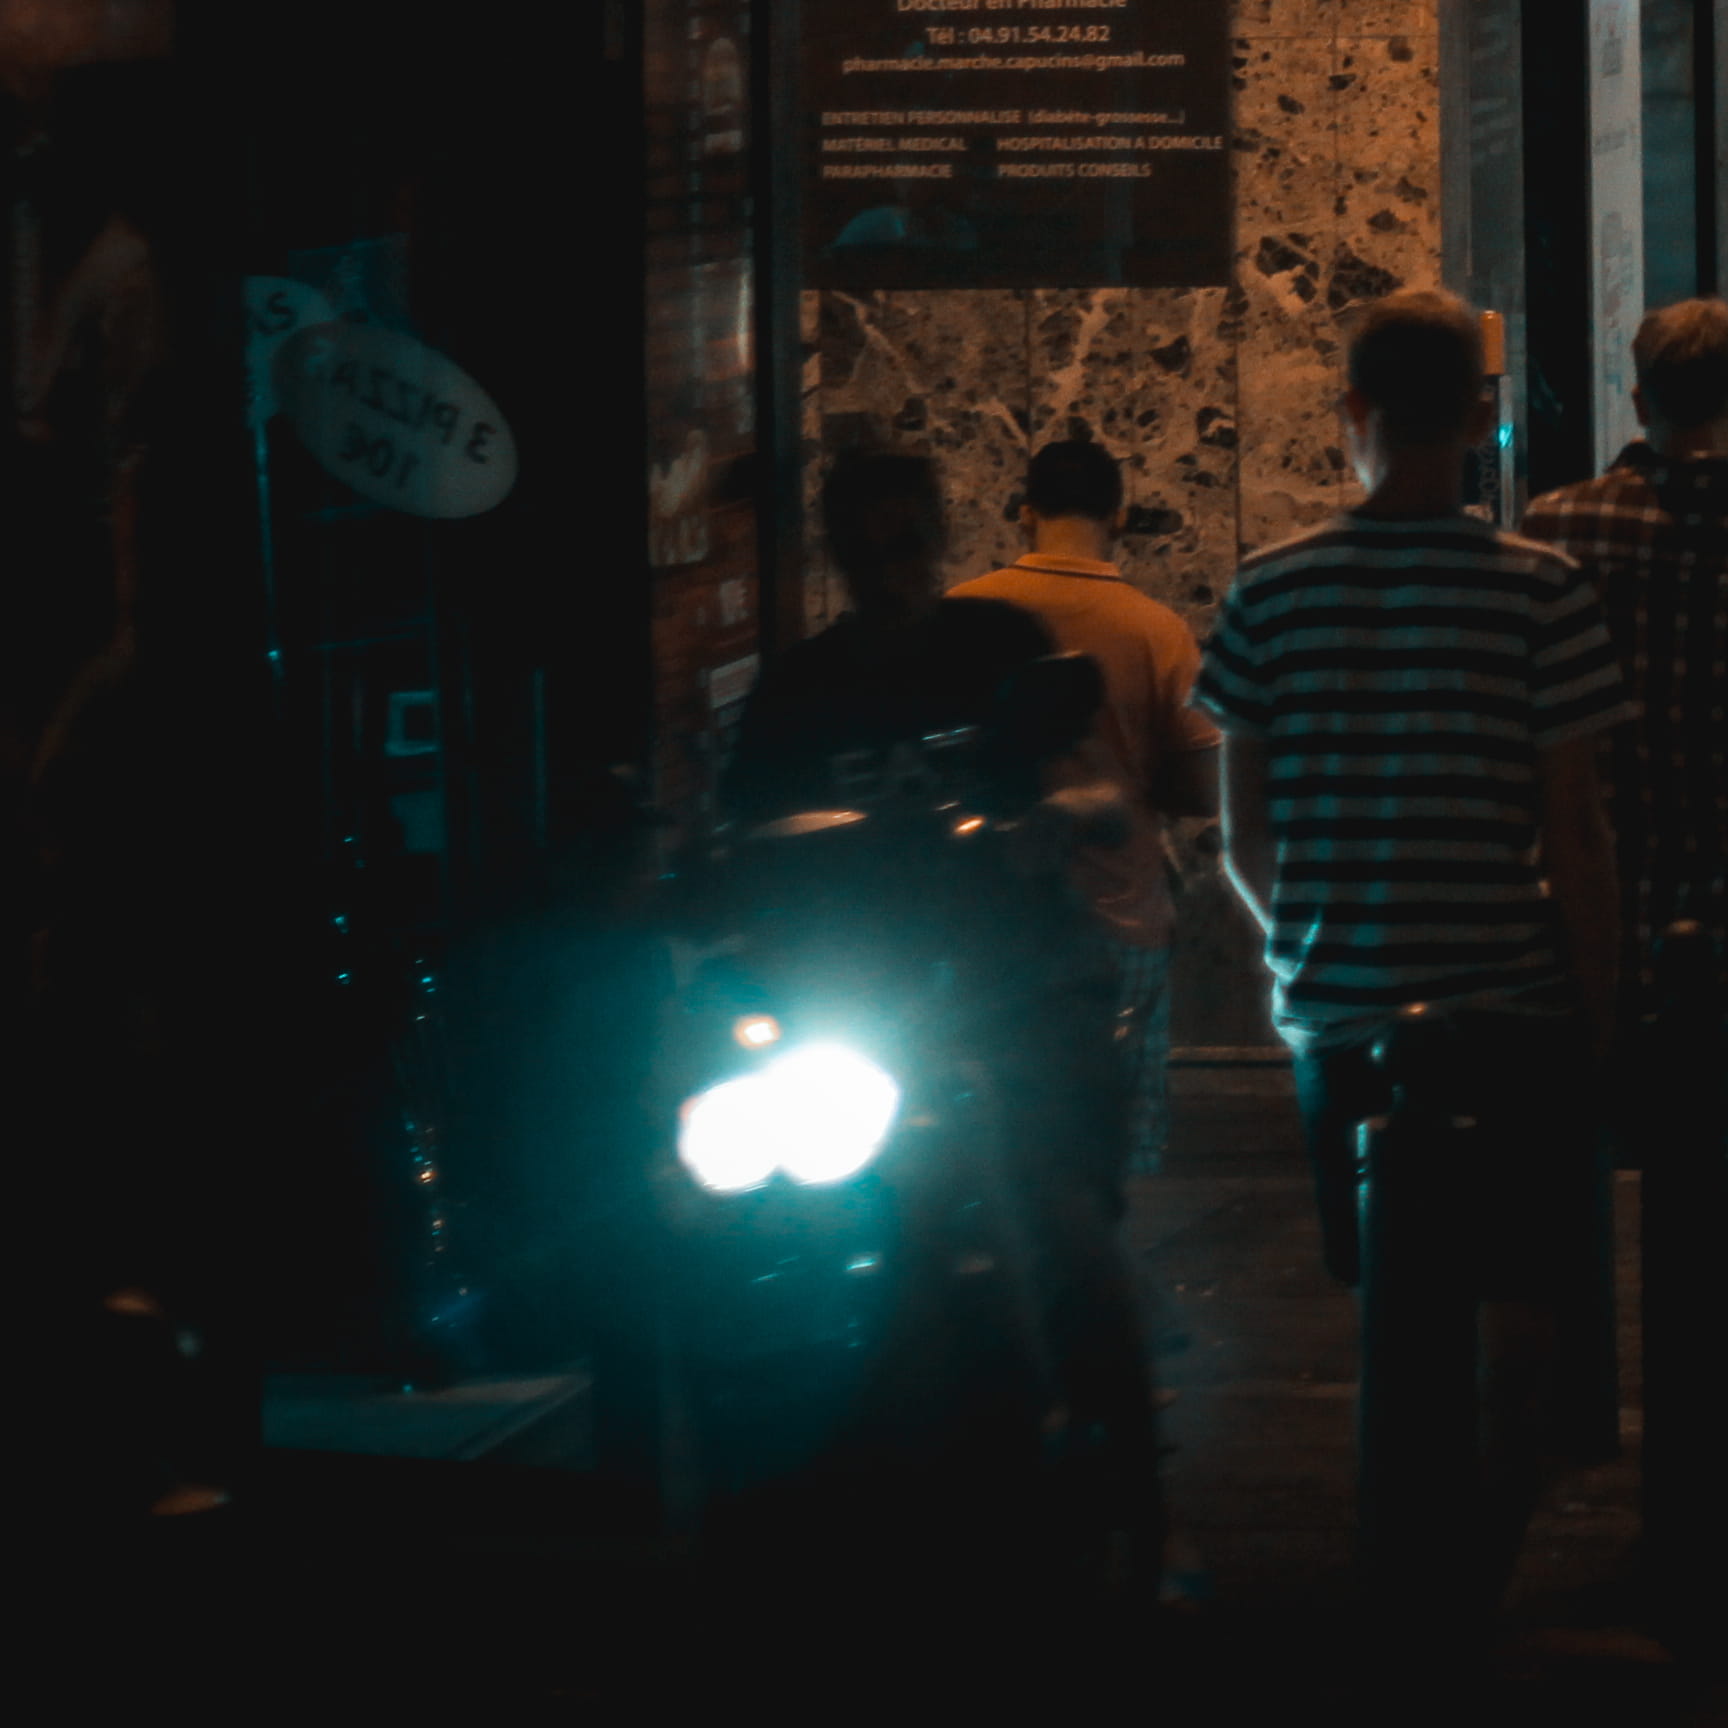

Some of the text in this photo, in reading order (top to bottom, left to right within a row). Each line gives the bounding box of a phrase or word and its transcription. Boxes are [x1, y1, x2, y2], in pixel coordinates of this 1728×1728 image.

[968, 24, 1112, 45] 04.91.54.24.82
[841, 50, 1187, 75] pharmacie.marche.capucins@gmail.com
[822, 110, 906, 127] ENTRETIEN
[996, 136, 1131, 152] HOSPITALISATION
[1148, 135, 1225, 150] DOMICILE
[822, 163, 954, 179] PARAPHARMACIE
[997, 162, 1154, 178] PRODUITS CONSEILS
